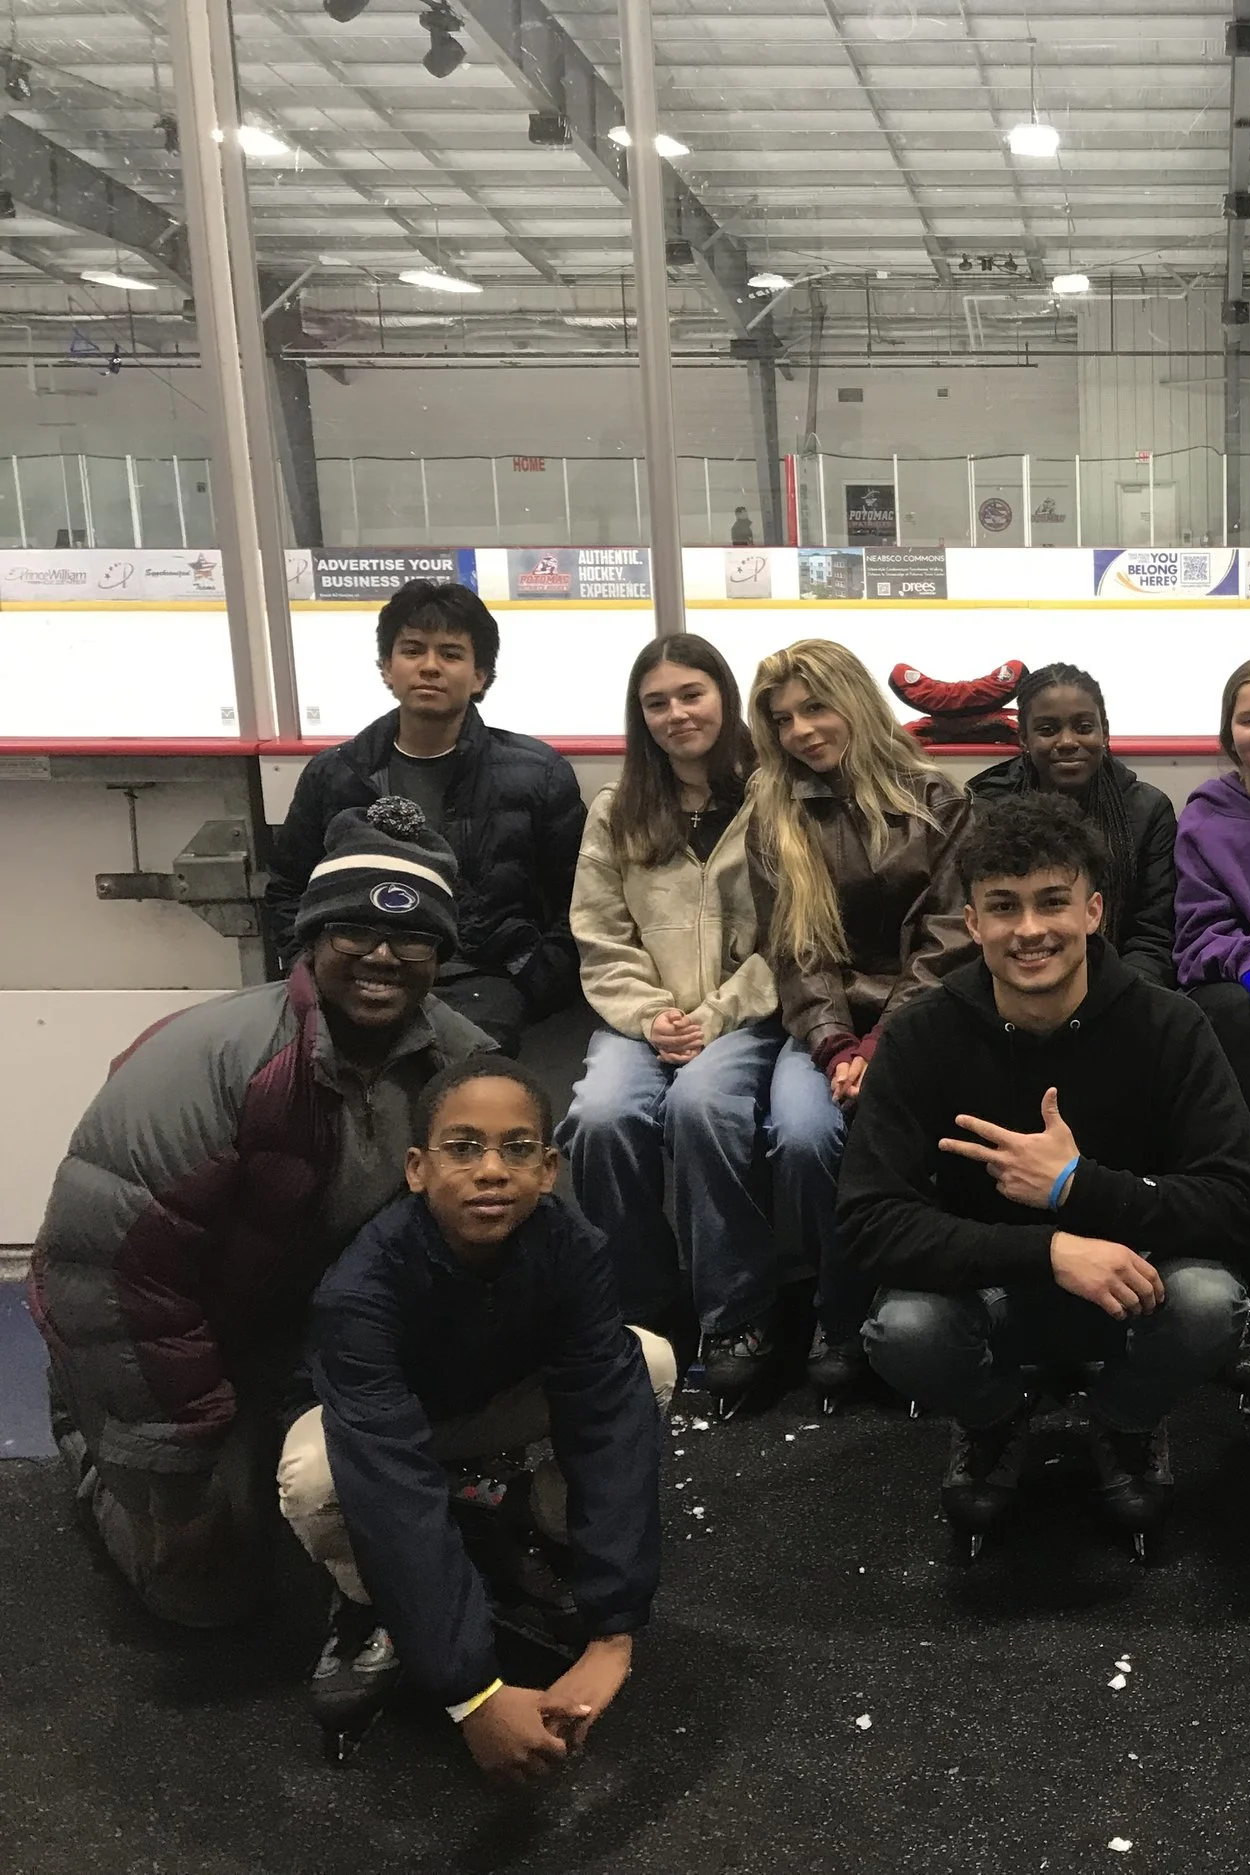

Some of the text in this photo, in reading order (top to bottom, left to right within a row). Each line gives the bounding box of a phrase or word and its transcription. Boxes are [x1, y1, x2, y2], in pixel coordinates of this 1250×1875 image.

[513, 457, 545, 472] HOME
[849, 510, 894, 520] POTOMAC
[578, 550, 643, 565] AUTHENTIC.
[903, 554, 945, 562] COMMONS
[1150, 553, 1178, 563] YOU
[317, 559, 453, 571] ADVERTISE YOUR
[1128, 564, 1178, 575] BELONG
[578, 566, 626, 581] HOCKEY.
[322, 576, 400, 588] BUSINESS
[1140, 576, 1170, 586] HERE
[580, 583, 650, 598] EXPERIENCE.
